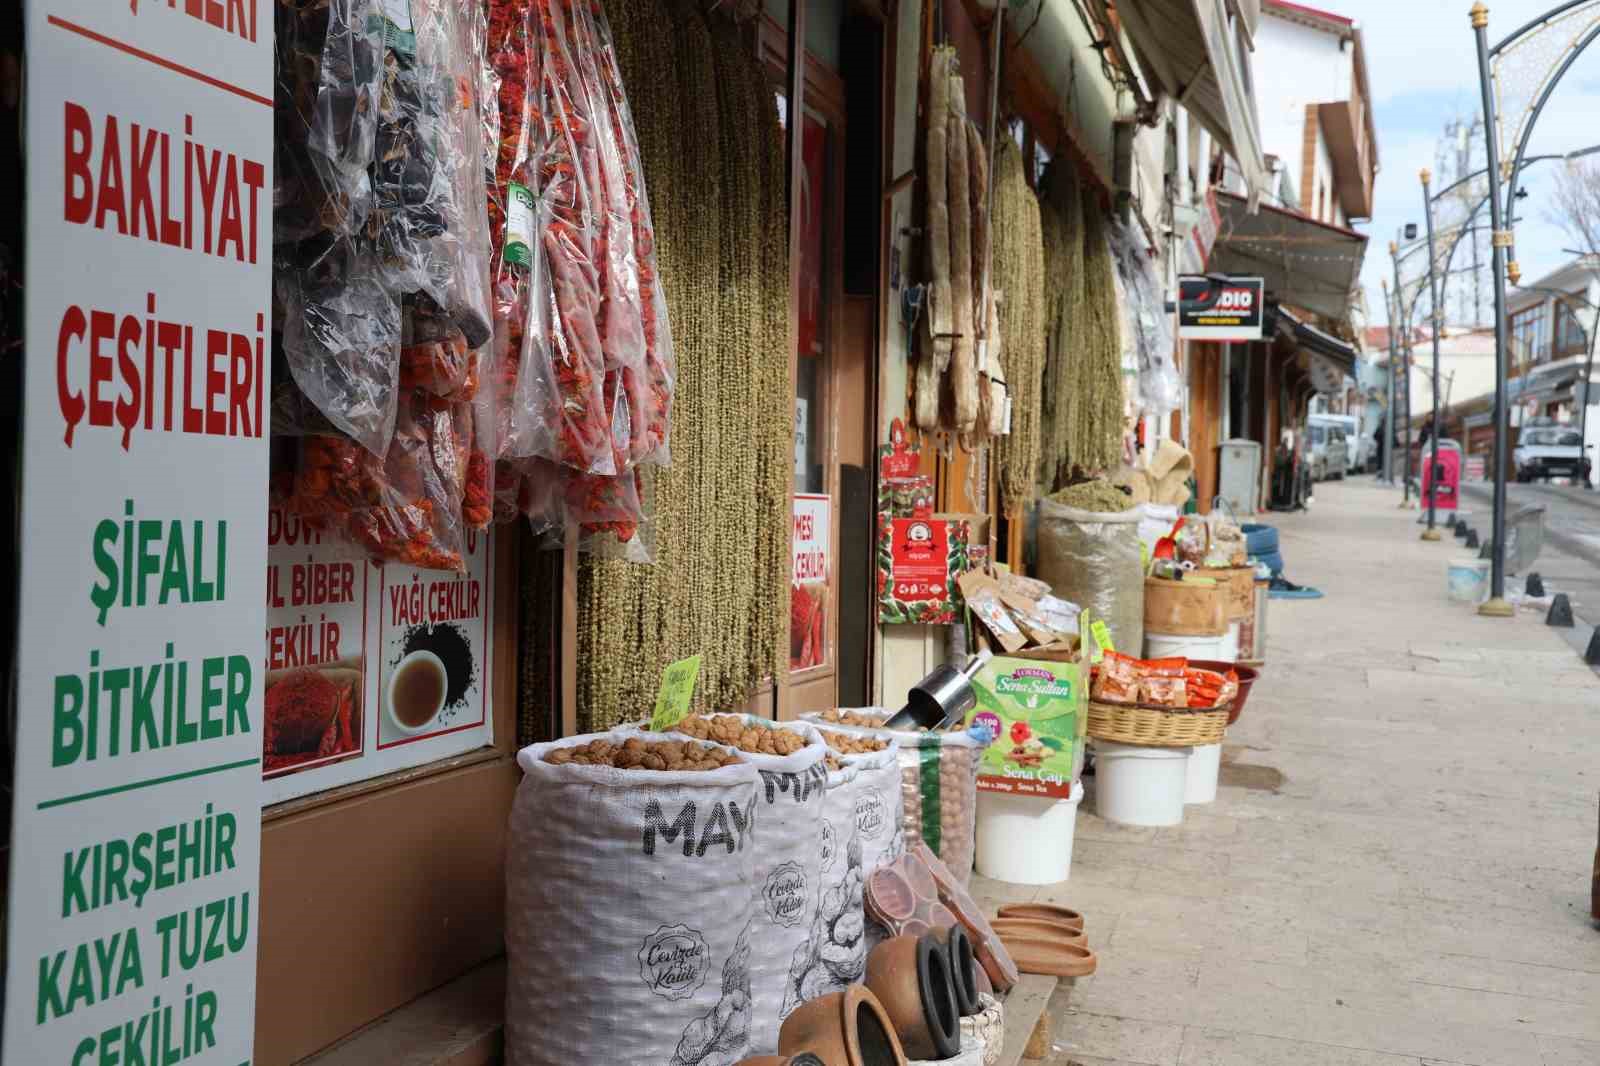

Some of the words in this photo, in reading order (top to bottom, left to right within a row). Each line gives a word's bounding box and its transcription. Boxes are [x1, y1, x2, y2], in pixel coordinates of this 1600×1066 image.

[64, 101, 265, 265] BAKLİYAT
[57, 292, 264, 452] ÇEŞİTLERİ
[90, 499, 227, 627] ŞİFALI
[291, 554, 355, 607] BİBER
[390, 572, 425, 626] YAĞI
[428, 571, 481, 635] ÇEKİLİR
[52, 642, 252, 769] BİTKİLER
[61, 803, 238, 918] KIRŞEHİR
[36, 927, 144, 1026] KAYA
[155, 892, 250, 980] TUZU
